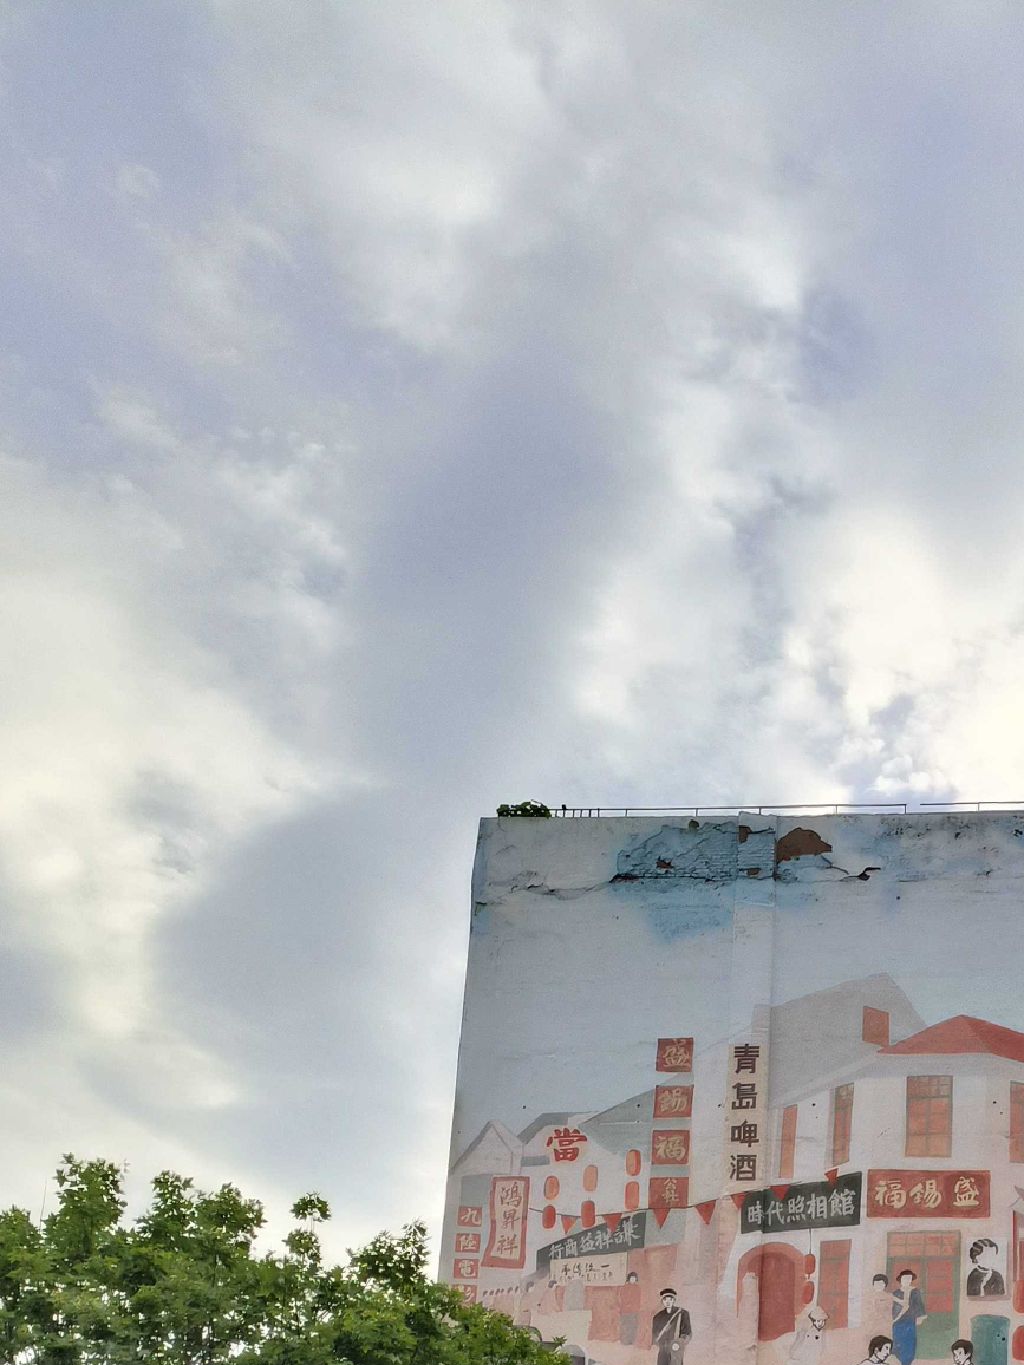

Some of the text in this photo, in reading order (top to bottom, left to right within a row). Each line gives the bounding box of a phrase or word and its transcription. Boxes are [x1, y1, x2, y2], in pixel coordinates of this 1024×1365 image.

[729, 1043, 760, 1182] 青島啤酒
[546, 1127, 587, 1162] 當
[747, 1188, 856, 1226] 時代照相館
